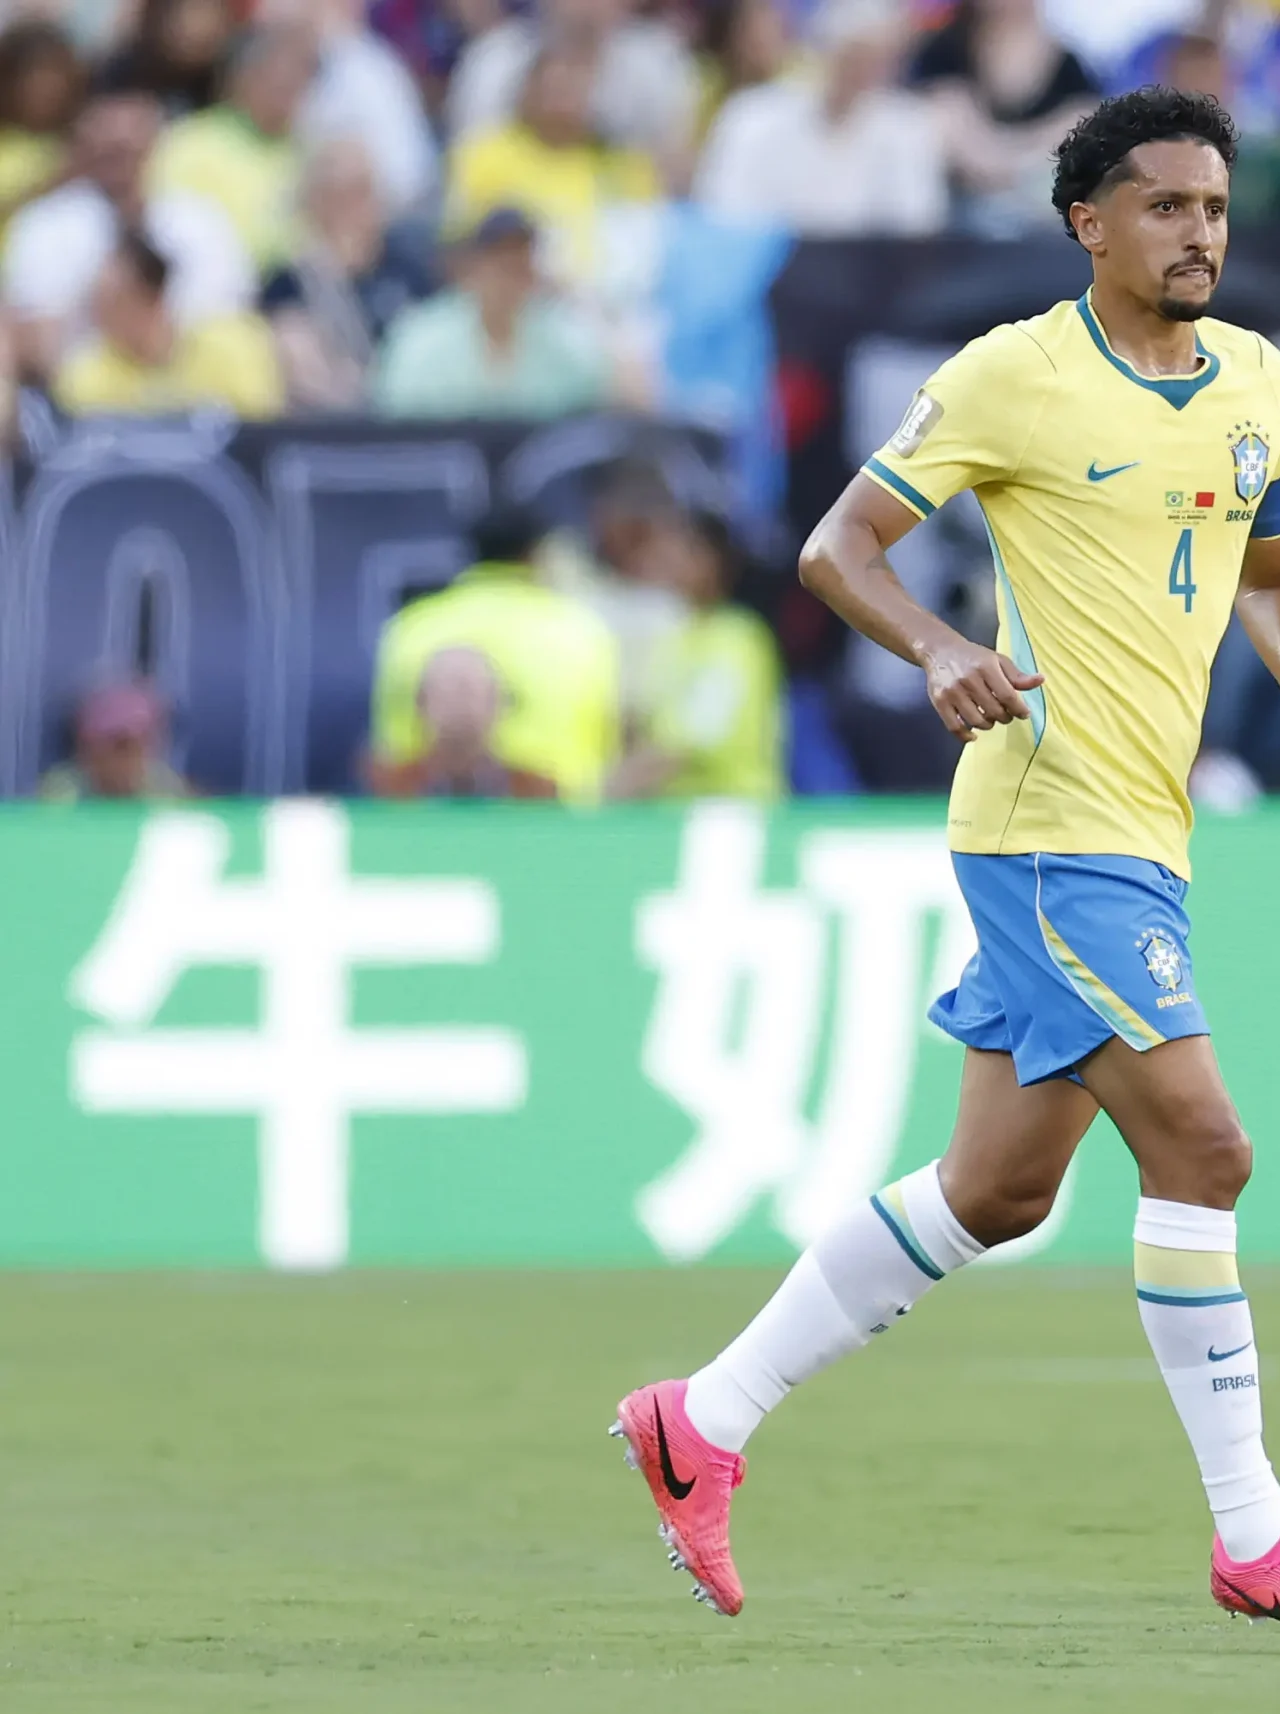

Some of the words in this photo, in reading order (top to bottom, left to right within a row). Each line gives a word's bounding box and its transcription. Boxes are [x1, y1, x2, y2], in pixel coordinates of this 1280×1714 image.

[1245, 462, 1260, 472] CBF
[1169, 529, 1196, 613] 4
[69, 799, 1072, 1268] 牛奶
[1212, 1373, 1257, 1392] BRASIL
